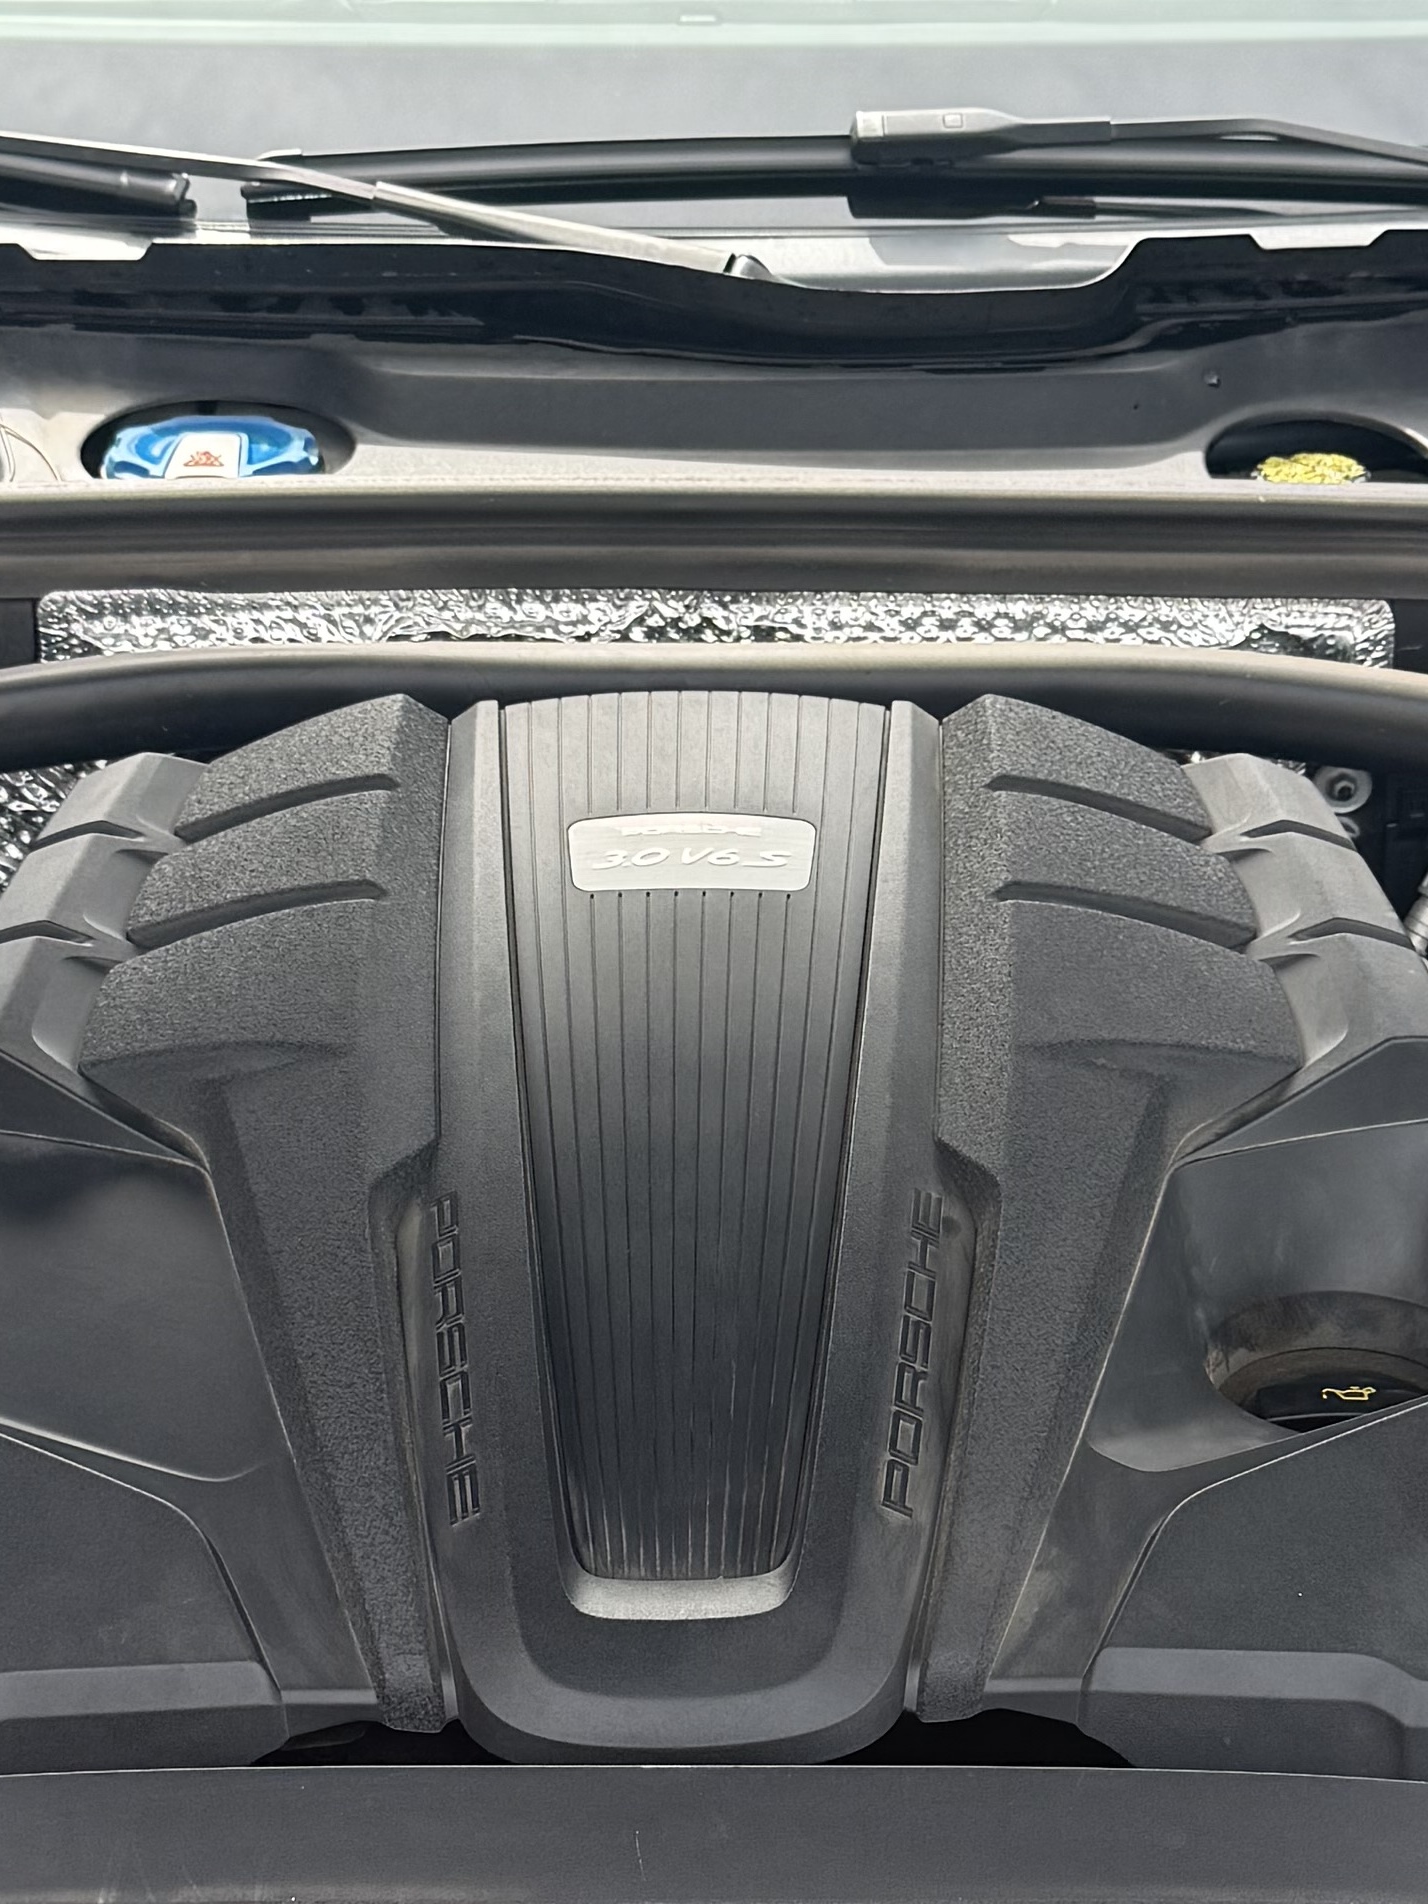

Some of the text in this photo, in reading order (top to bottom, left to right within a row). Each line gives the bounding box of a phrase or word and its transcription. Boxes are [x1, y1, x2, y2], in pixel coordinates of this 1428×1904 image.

[592, 847, 793, 870] 3.0 V6 S
[429, 1190, 481, 1526] PORSCHE
[880, 1188, 943, 1517] PORSCHE
